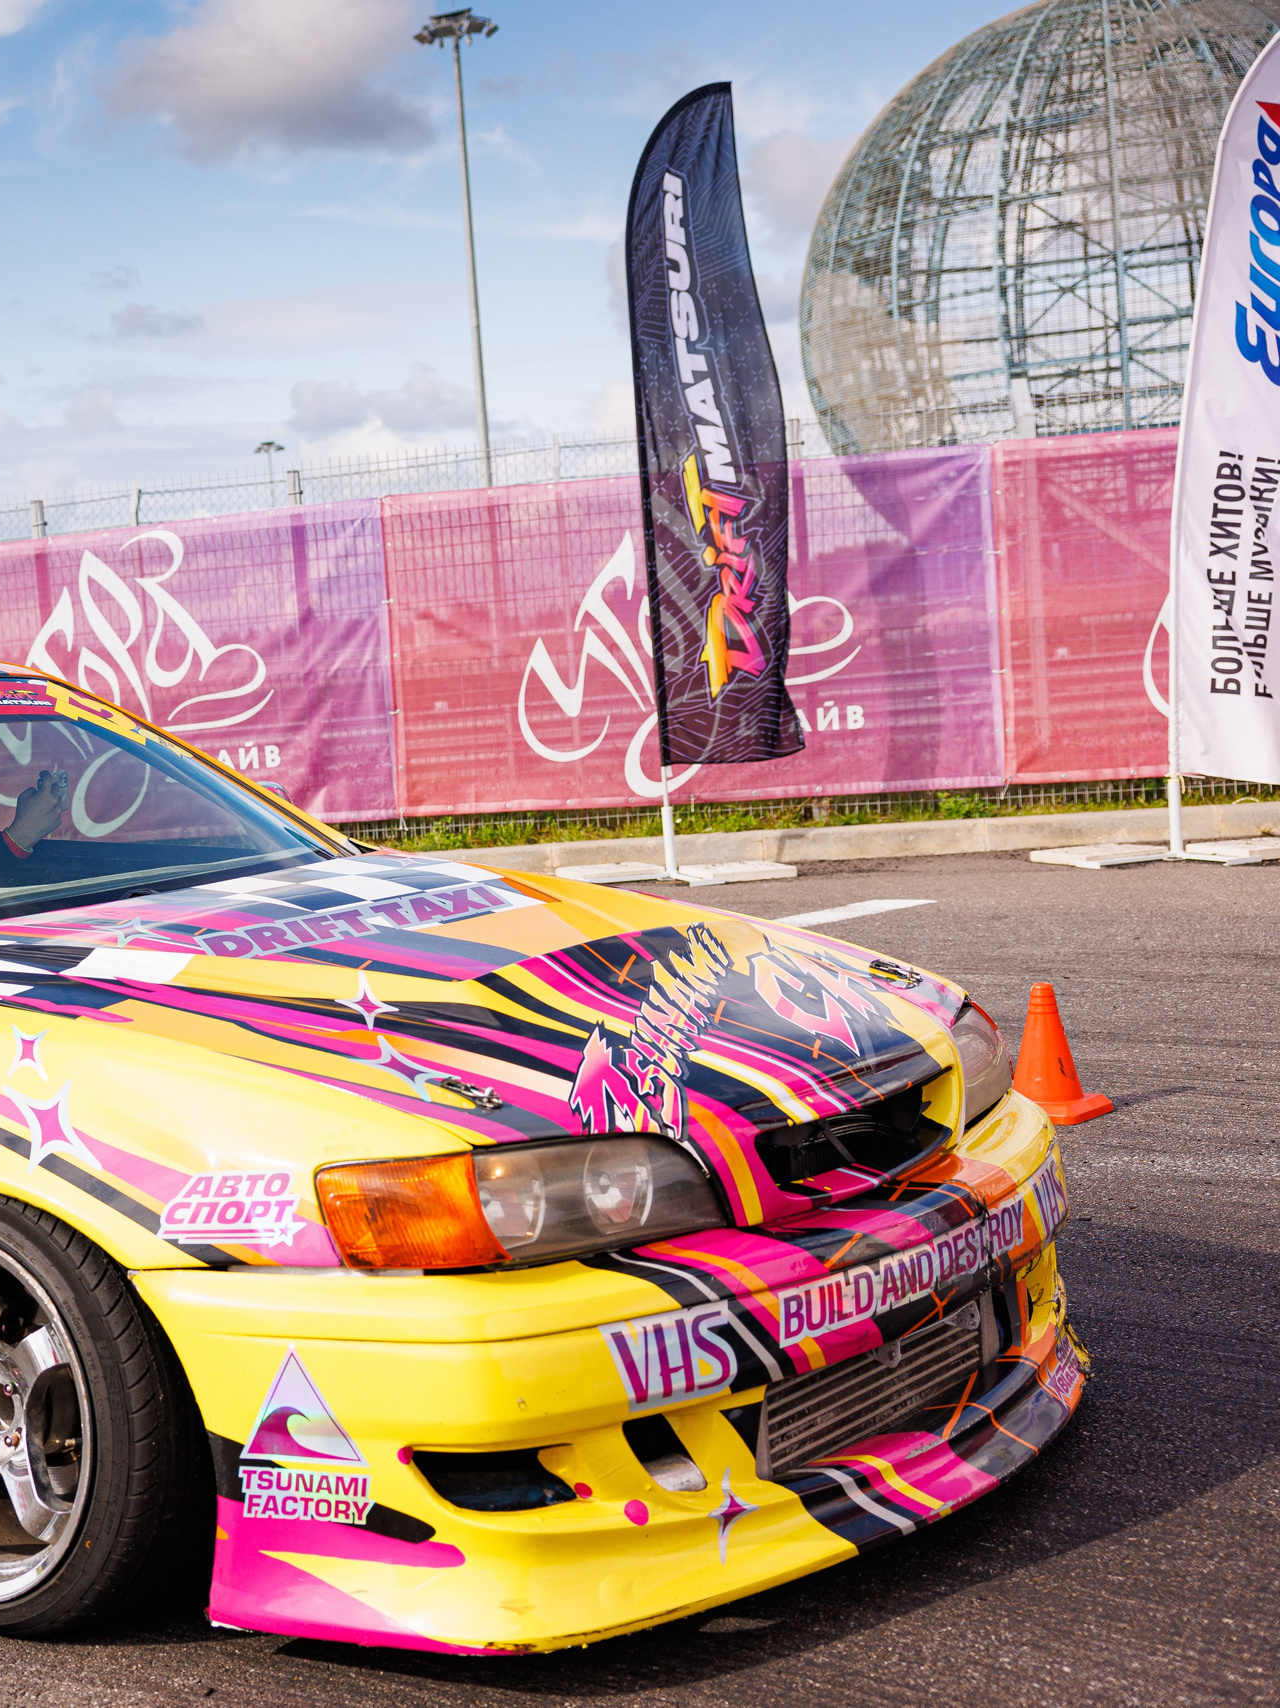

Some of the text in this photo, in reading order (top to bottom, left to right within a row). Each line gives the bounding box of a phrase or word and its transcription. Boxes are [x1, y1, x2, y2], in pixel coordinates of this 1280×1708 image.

[663, 172, 737, 483] MATSURI
[1208, 450, 1246, 561] ХИТОВ!
[202, 885, 506, 958] DRIFT TAXI
[164, 1200, 294, 1225] СПОРТ
[182, 1173, 291, 1198] АВТО
[783, 1204, 1024, 1339] BUILD AND DESTROY
[609, 1310, 732, 1404] VHS
[241, 1470, 368, 1498] TSUNAMI
[246, 1494, 370, 1521] FACTORY
